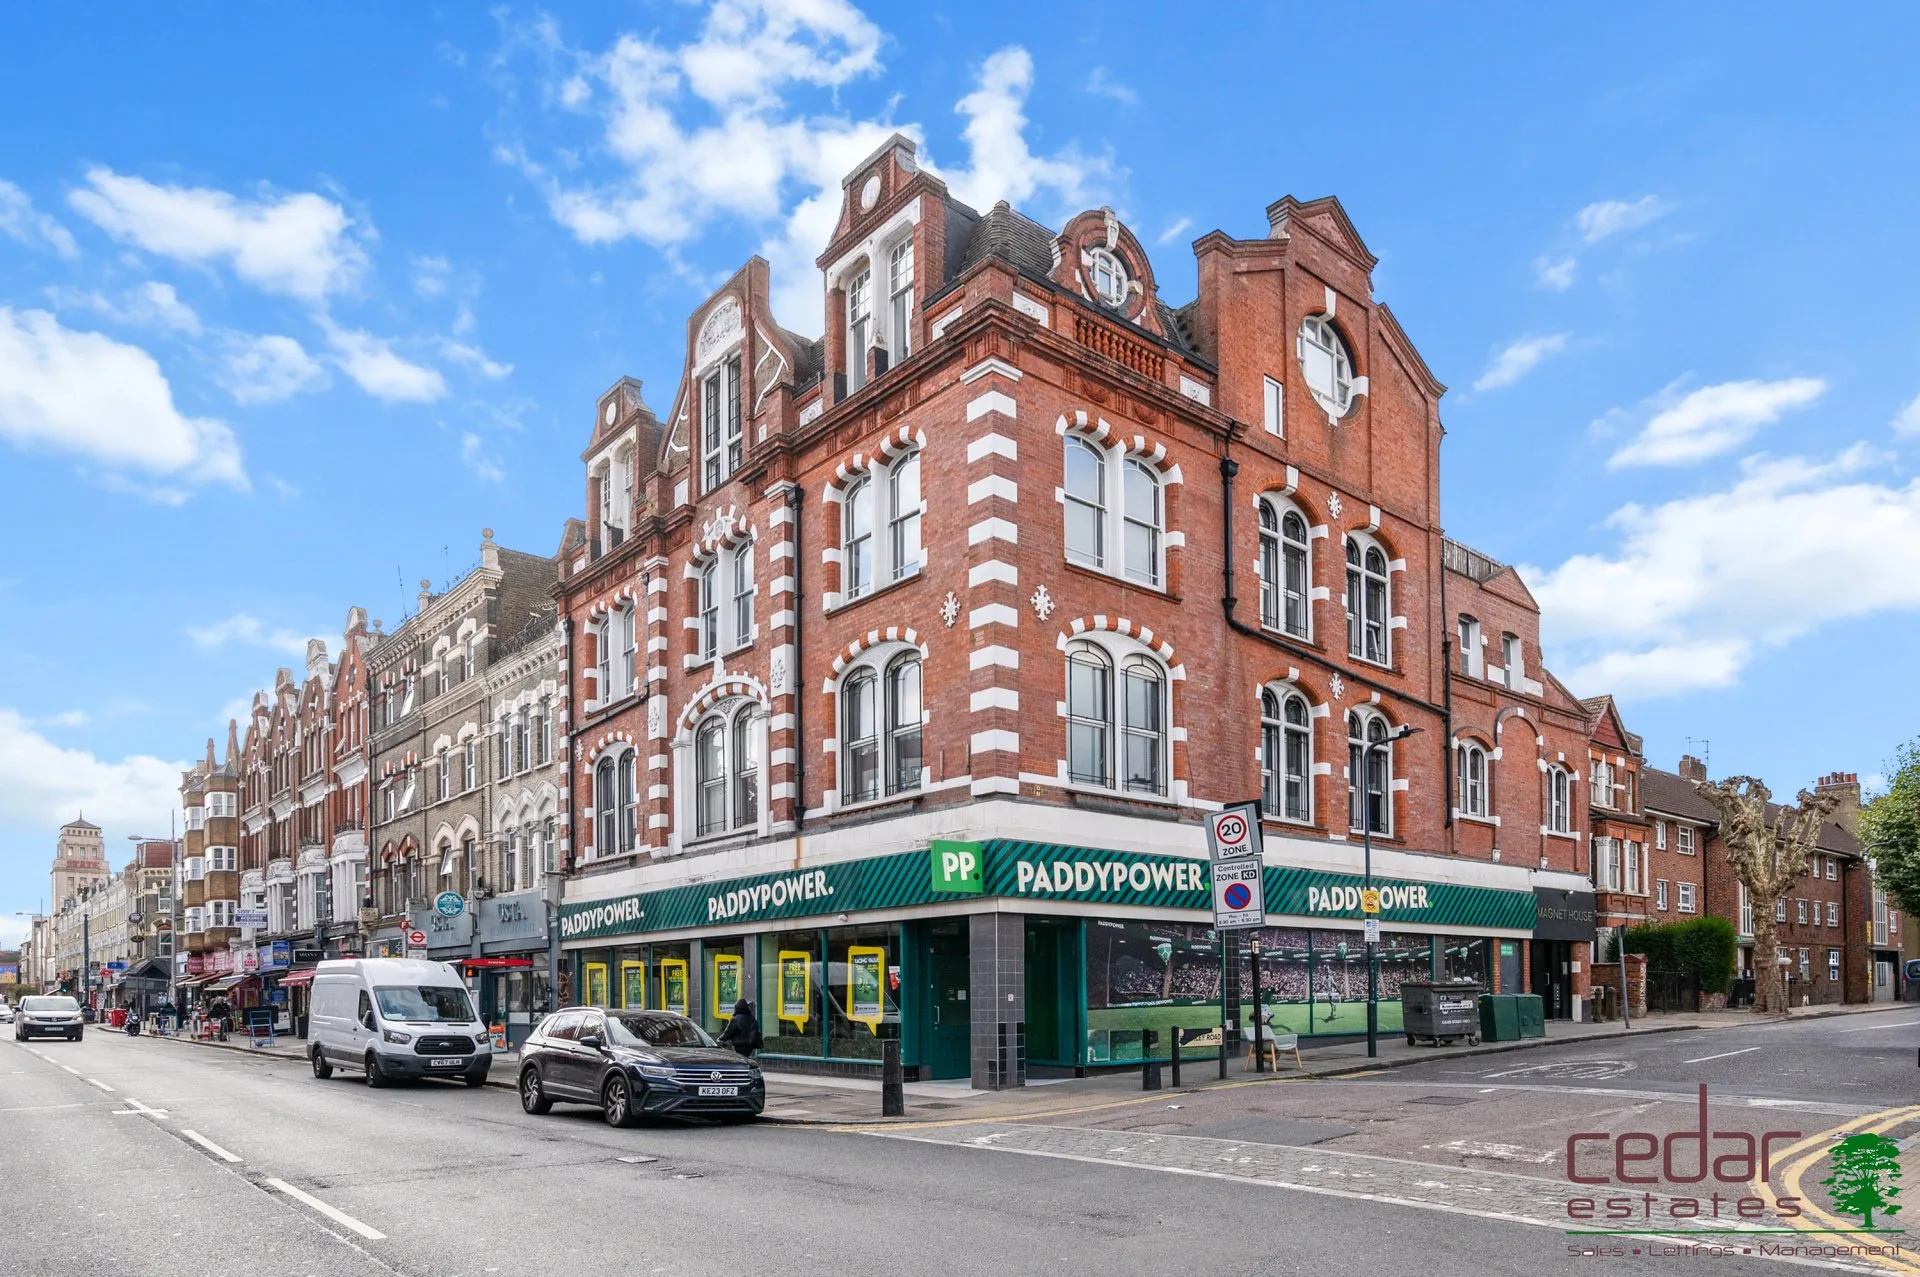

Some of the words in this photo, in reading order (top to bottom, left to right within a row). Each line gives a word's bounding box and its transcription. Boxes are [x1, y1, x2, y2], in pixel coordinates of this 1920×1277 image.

[1221, 822, 1242, 836] 20
[1222, 844, 1248, 856] ZONE
[1218, 863, 1254, 872] Controlled
[1017, 860, 1210, 892] PADDYPOWER.
[1216, 873, 1239, 881] ZONE
[708, 870, 834, 921] PADDYPOWER.
[562, 898, 644, 936] PADDYPOWER.
[1538, 907, 1566, 920] MAGNET
[1569, 910, 1592, 922] HOUSE
